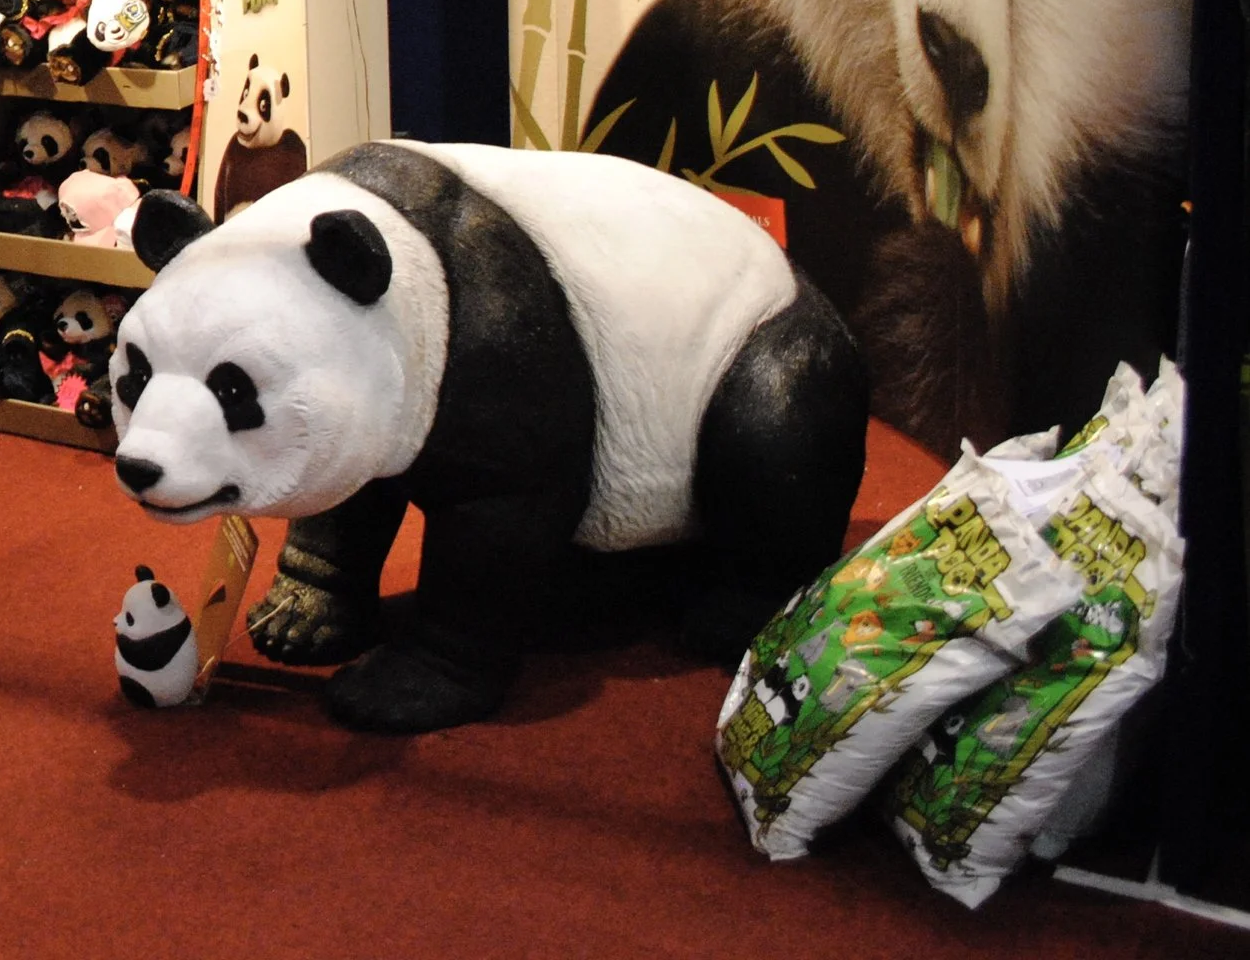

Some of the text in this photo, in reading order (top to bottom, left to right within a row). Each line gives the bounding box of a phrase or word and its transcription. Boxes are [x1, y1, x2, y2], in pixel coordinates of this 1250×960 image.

[925, 525, 976, 596] POO
[928, 492, 1012, 590] PANDA
[1057, 490, 1147, 582] PANDA
